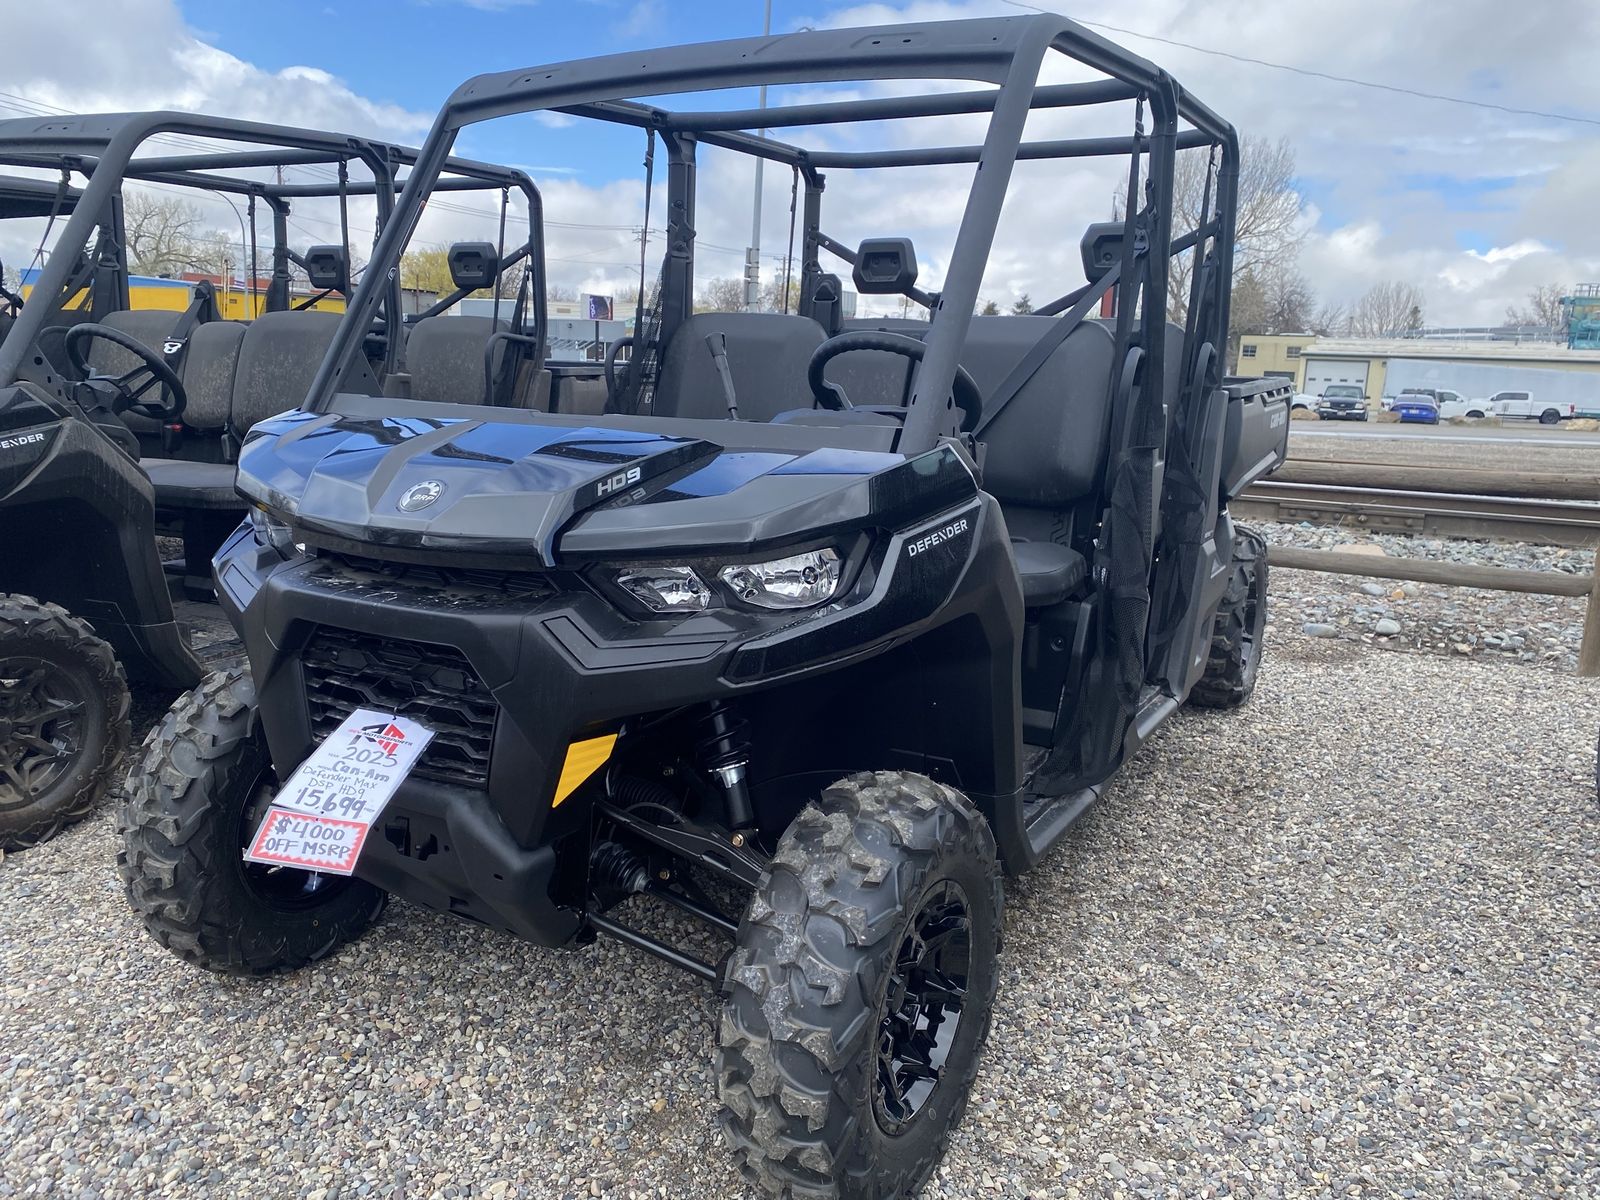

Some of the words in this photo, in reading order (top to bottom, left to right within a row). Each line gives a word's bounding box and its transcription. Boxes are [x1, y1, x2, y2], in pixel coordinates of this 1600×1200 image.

[0, 433, 45, 449] ENDER
[598, 466, 641, 497] HD9
[908, 519, 968, 557] DEFENDER
[363, 732, 414, 747] MOTORSPORTS
[342, 746, 398, 768] 2025
[332, 760, 390, 782] Can-Am
[308, 777, 334, 790] DSP
[338, 783, 366, 800] HD9
[354, 777, 379, 790] Max
[275, 816, 346, 841] $4000
[265, 837, 299, 853] OFF
[302, 841, 351, 859] MSRP
